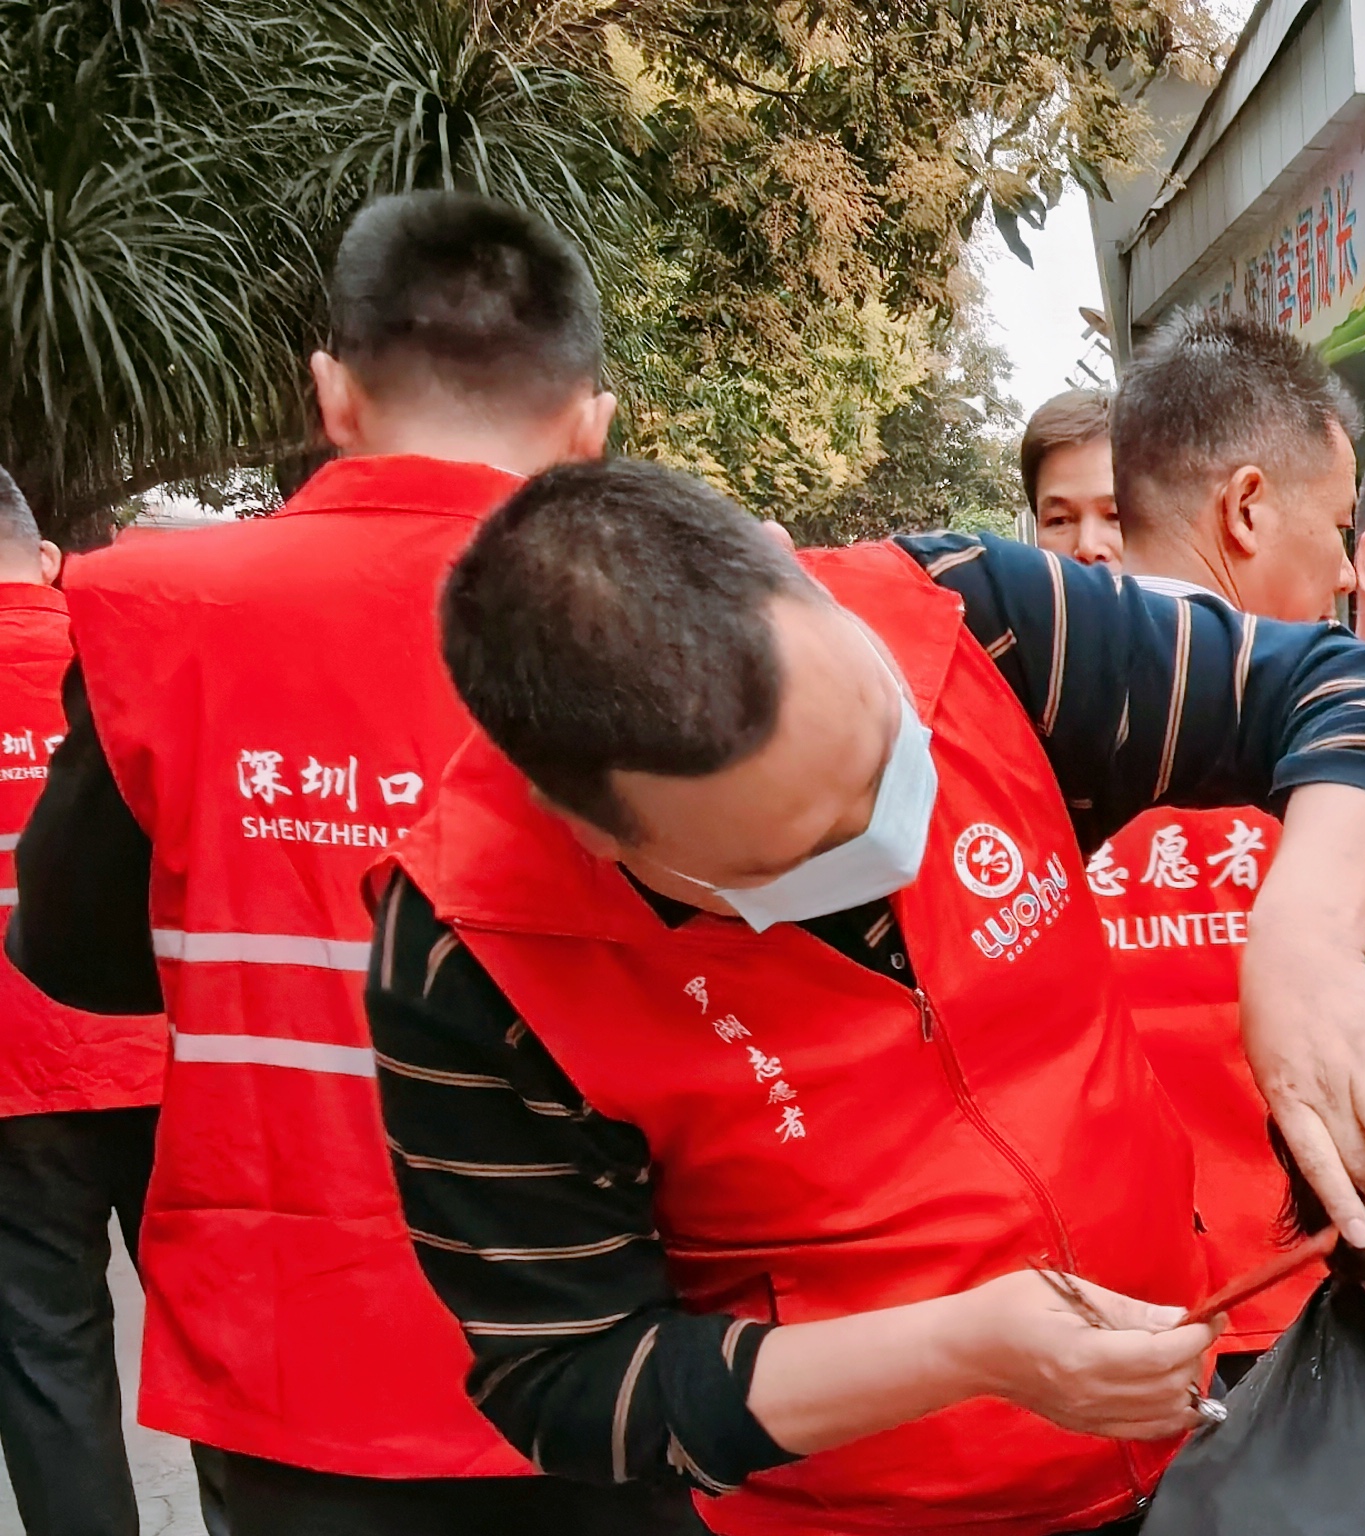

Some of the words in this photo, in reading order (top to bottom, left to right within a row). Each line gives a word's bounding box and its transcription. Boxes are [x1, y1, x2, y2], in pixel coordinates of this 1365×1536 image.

[236, 748, 424, 813] 深圳口
[241, 816, 388, 848] SHENZHEN
[1085, 819, 1266, 897] 志愿者
[1101, 911, 1252, 950] LUNTEE
